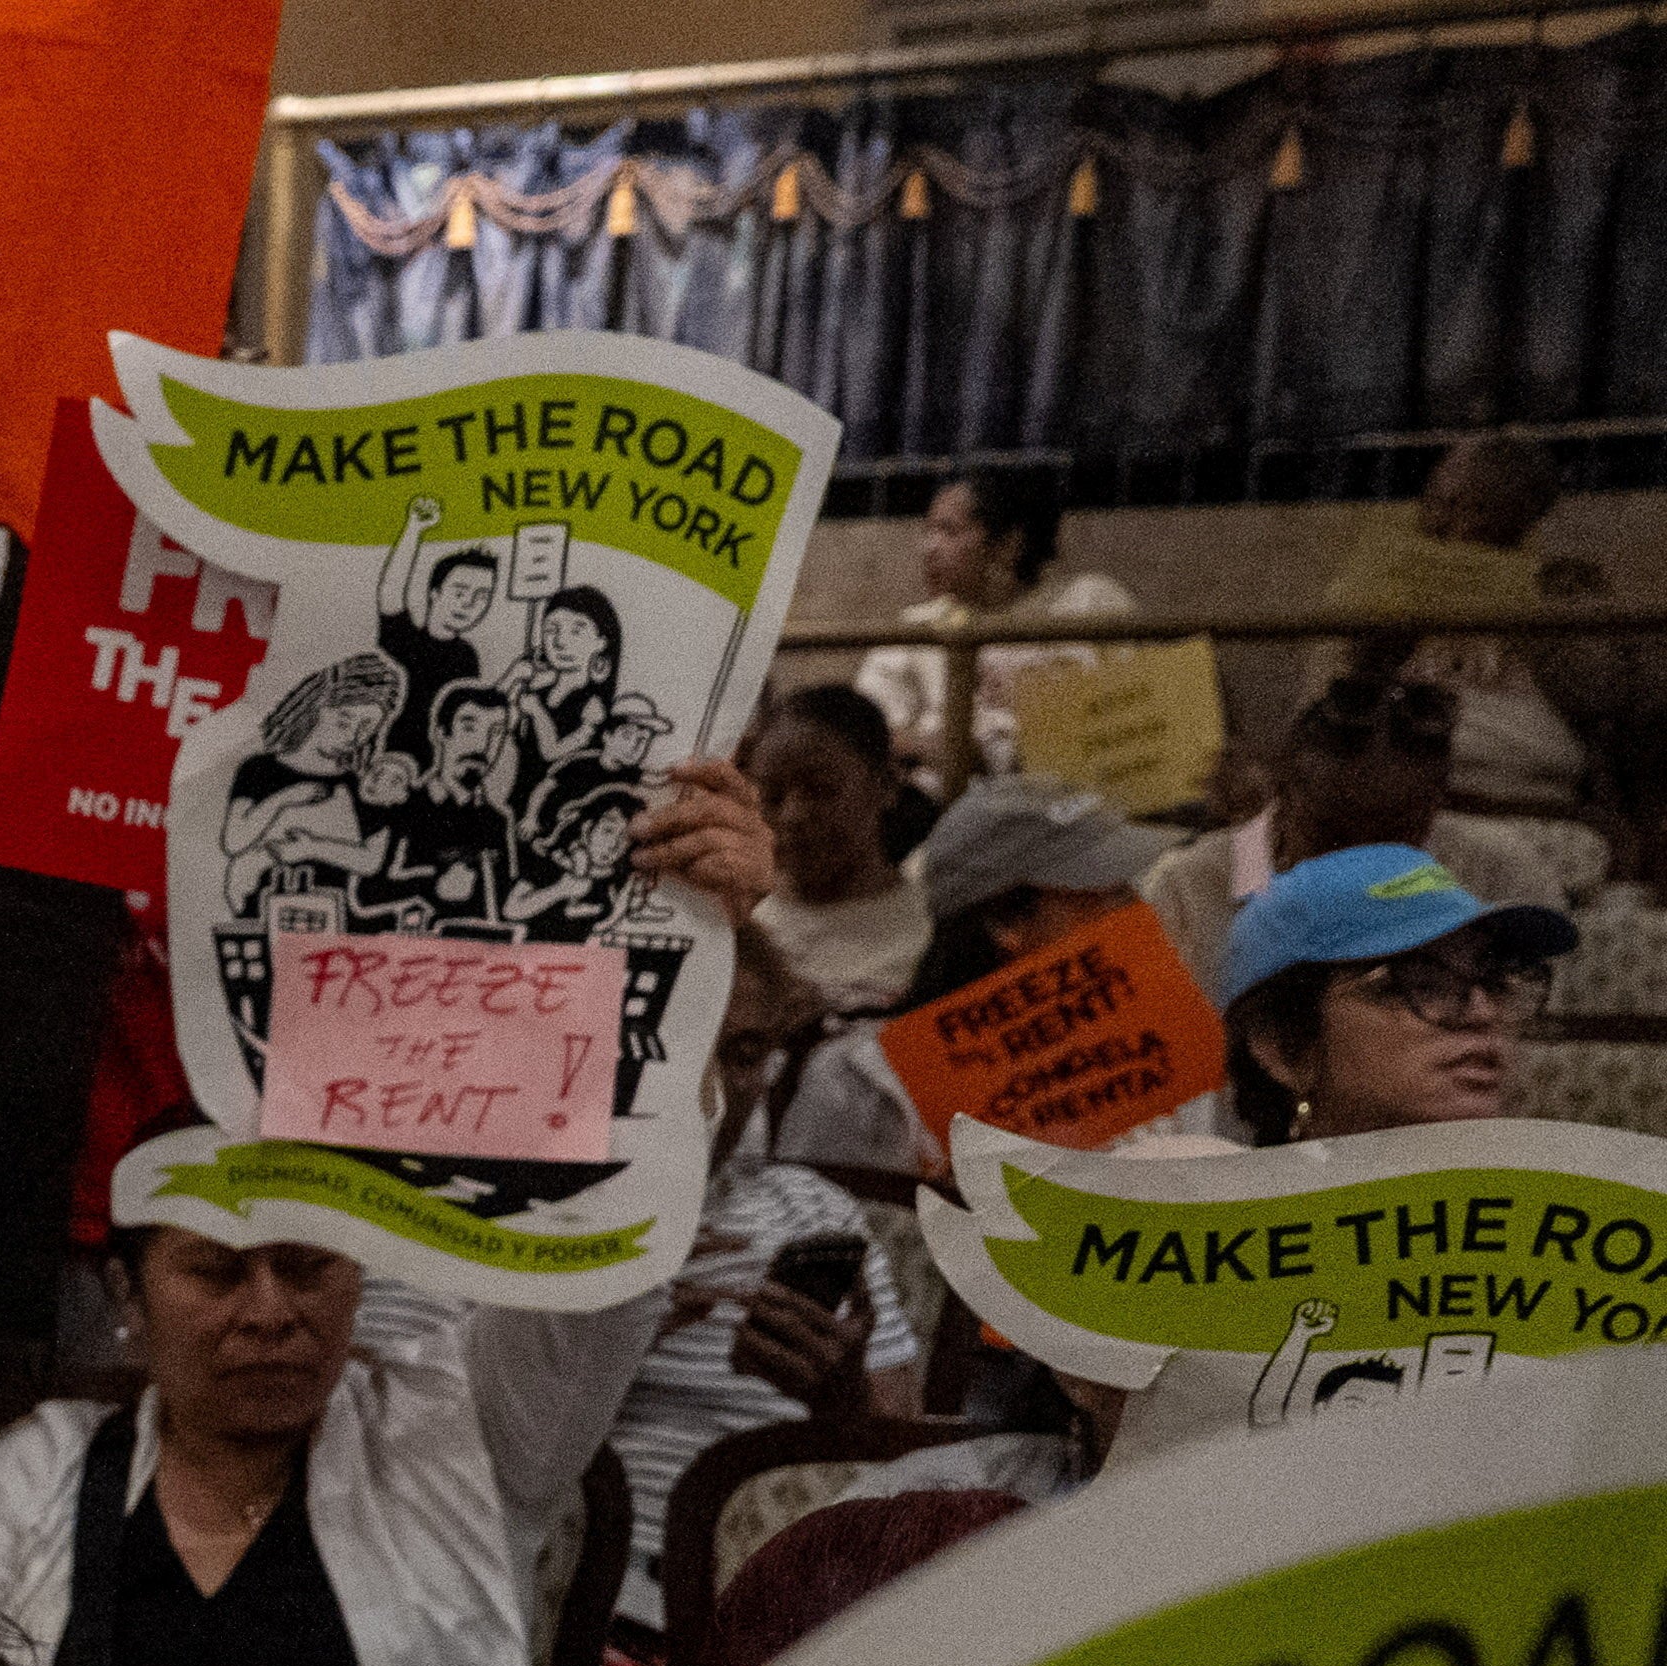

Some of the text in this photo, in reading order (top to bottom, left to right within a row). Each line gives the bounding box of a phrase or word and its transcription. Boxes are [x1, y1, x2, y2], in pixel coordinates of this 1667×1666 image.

[224, 400, 777, 507] MAKE THE ROAD
[481, 468, 755, 569] NEW YORK
[84, 625, 223, 738] THE
[67, 786, 120, 821] NO
[307, 946, 586, 1018] FREEZE
[373, 1031, 479, 1071] THE
[320, 1078, 520, 1133] RENT
[359, 1186, 504, 1259] COMUNIDAD
[533, 1238, 625, 1265] PODER
[1072, 1199, 1667, 1285] MAKE THE RO
[1386, 1275, 1667, 1343] NEW YO
